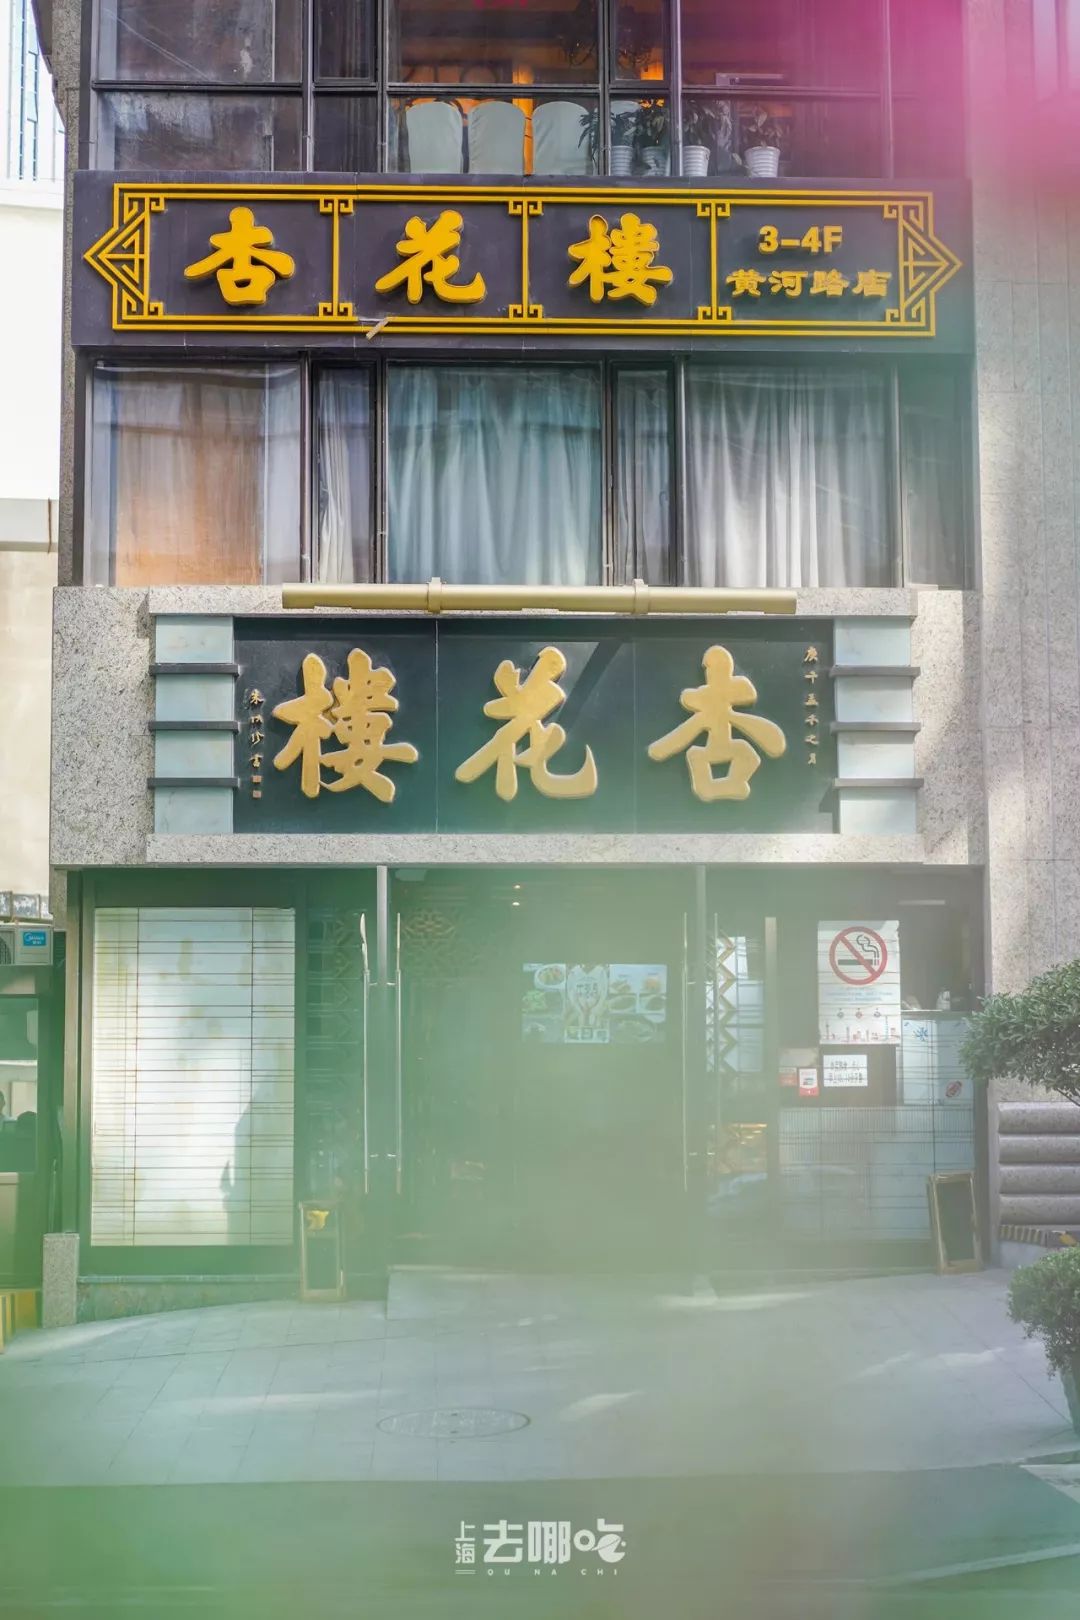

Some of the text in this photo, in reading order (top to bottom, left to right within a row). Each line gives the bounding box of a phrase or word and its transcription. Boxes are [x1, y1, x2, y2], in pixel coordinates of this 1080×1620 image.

[758, 225, 843, 254] 3-4F
[184, 207, 674, 307] 杏花樓
[726, 268, 892, 297] 黄河路店
